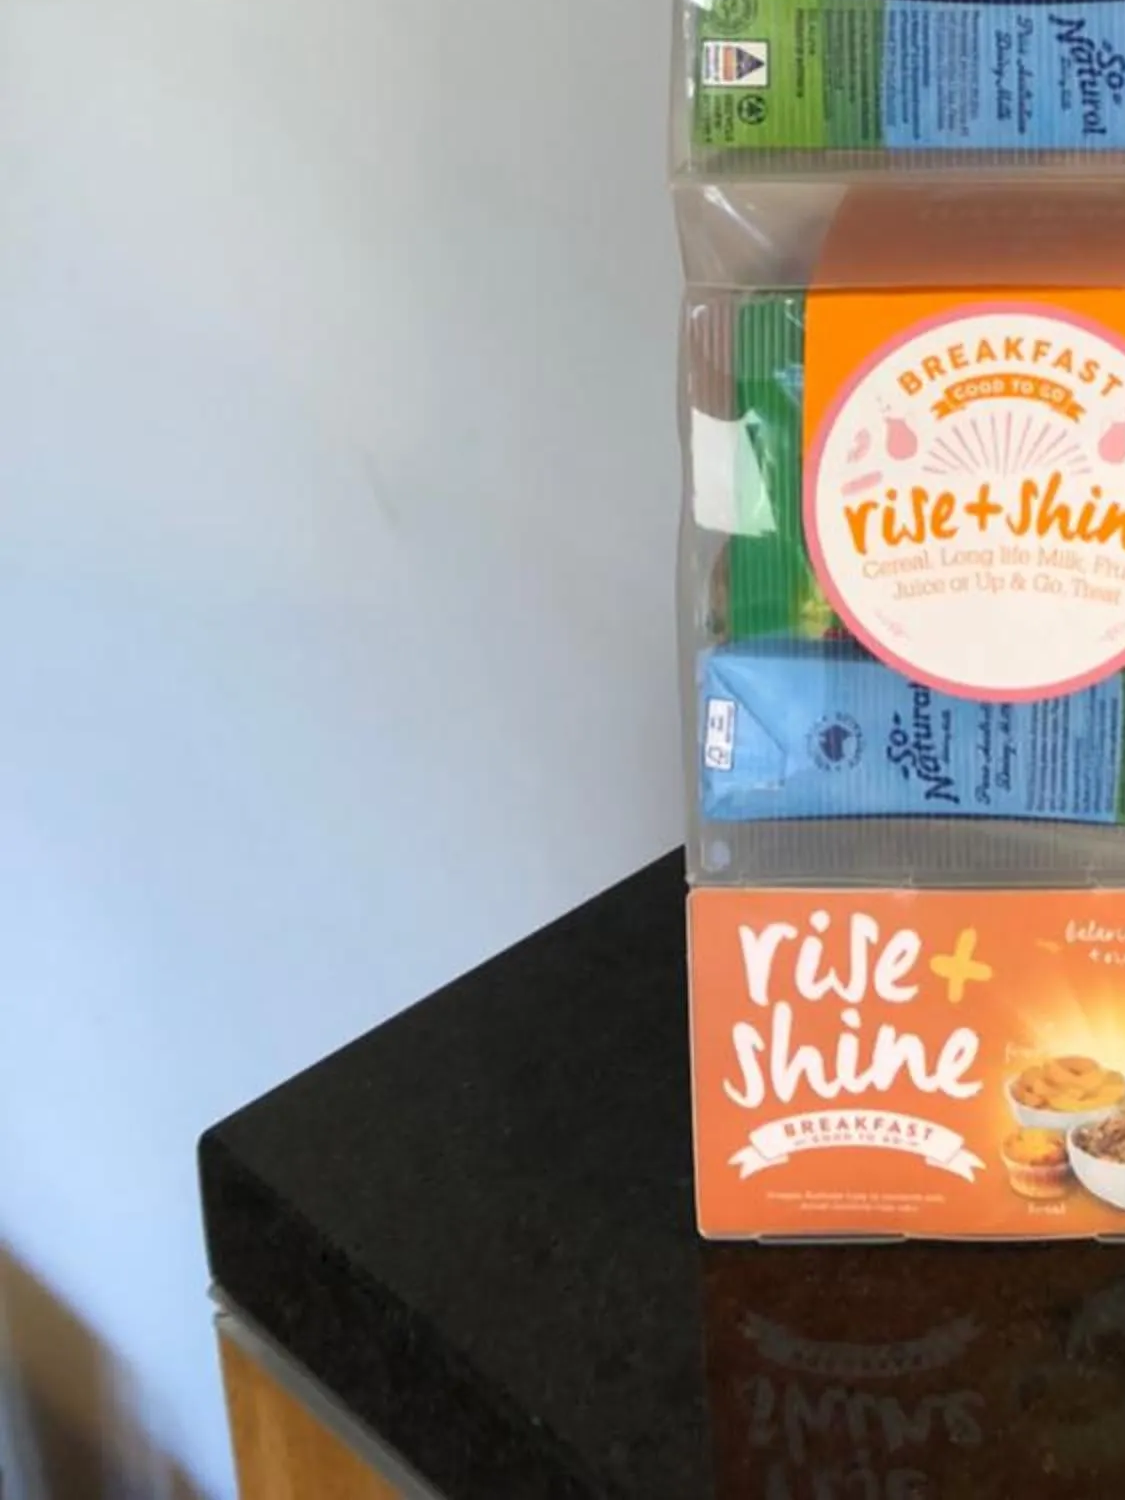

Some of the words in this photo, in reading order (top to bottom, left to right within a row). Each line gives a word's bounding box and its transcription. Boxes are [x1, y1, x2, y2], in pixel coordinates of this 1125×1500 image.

[1048, 14, 1107, 137] Natural
[897, 336, 1125, 399] BREAKFAST
[953, 378, 1006, 403] GOOD
[1010, 378, 1035, 396] TO
[1039, 383, 1065, 404] GO
[862, 553, 935, 581] Cereal,
[940, 545, 994, 571] Long
[999, 545, 1031, 565] life
[892, 576, 947, 602] Juice
[950, 578, 970, 593] or
[976, 572, 1006, 598] Up
[1010, 573, 1028, 590] &
[1072, 576, 1122, 606] Treat
[723, 1001, 983, 1109] shine
[783, 1115, 934, 1142] BREAKFAST
